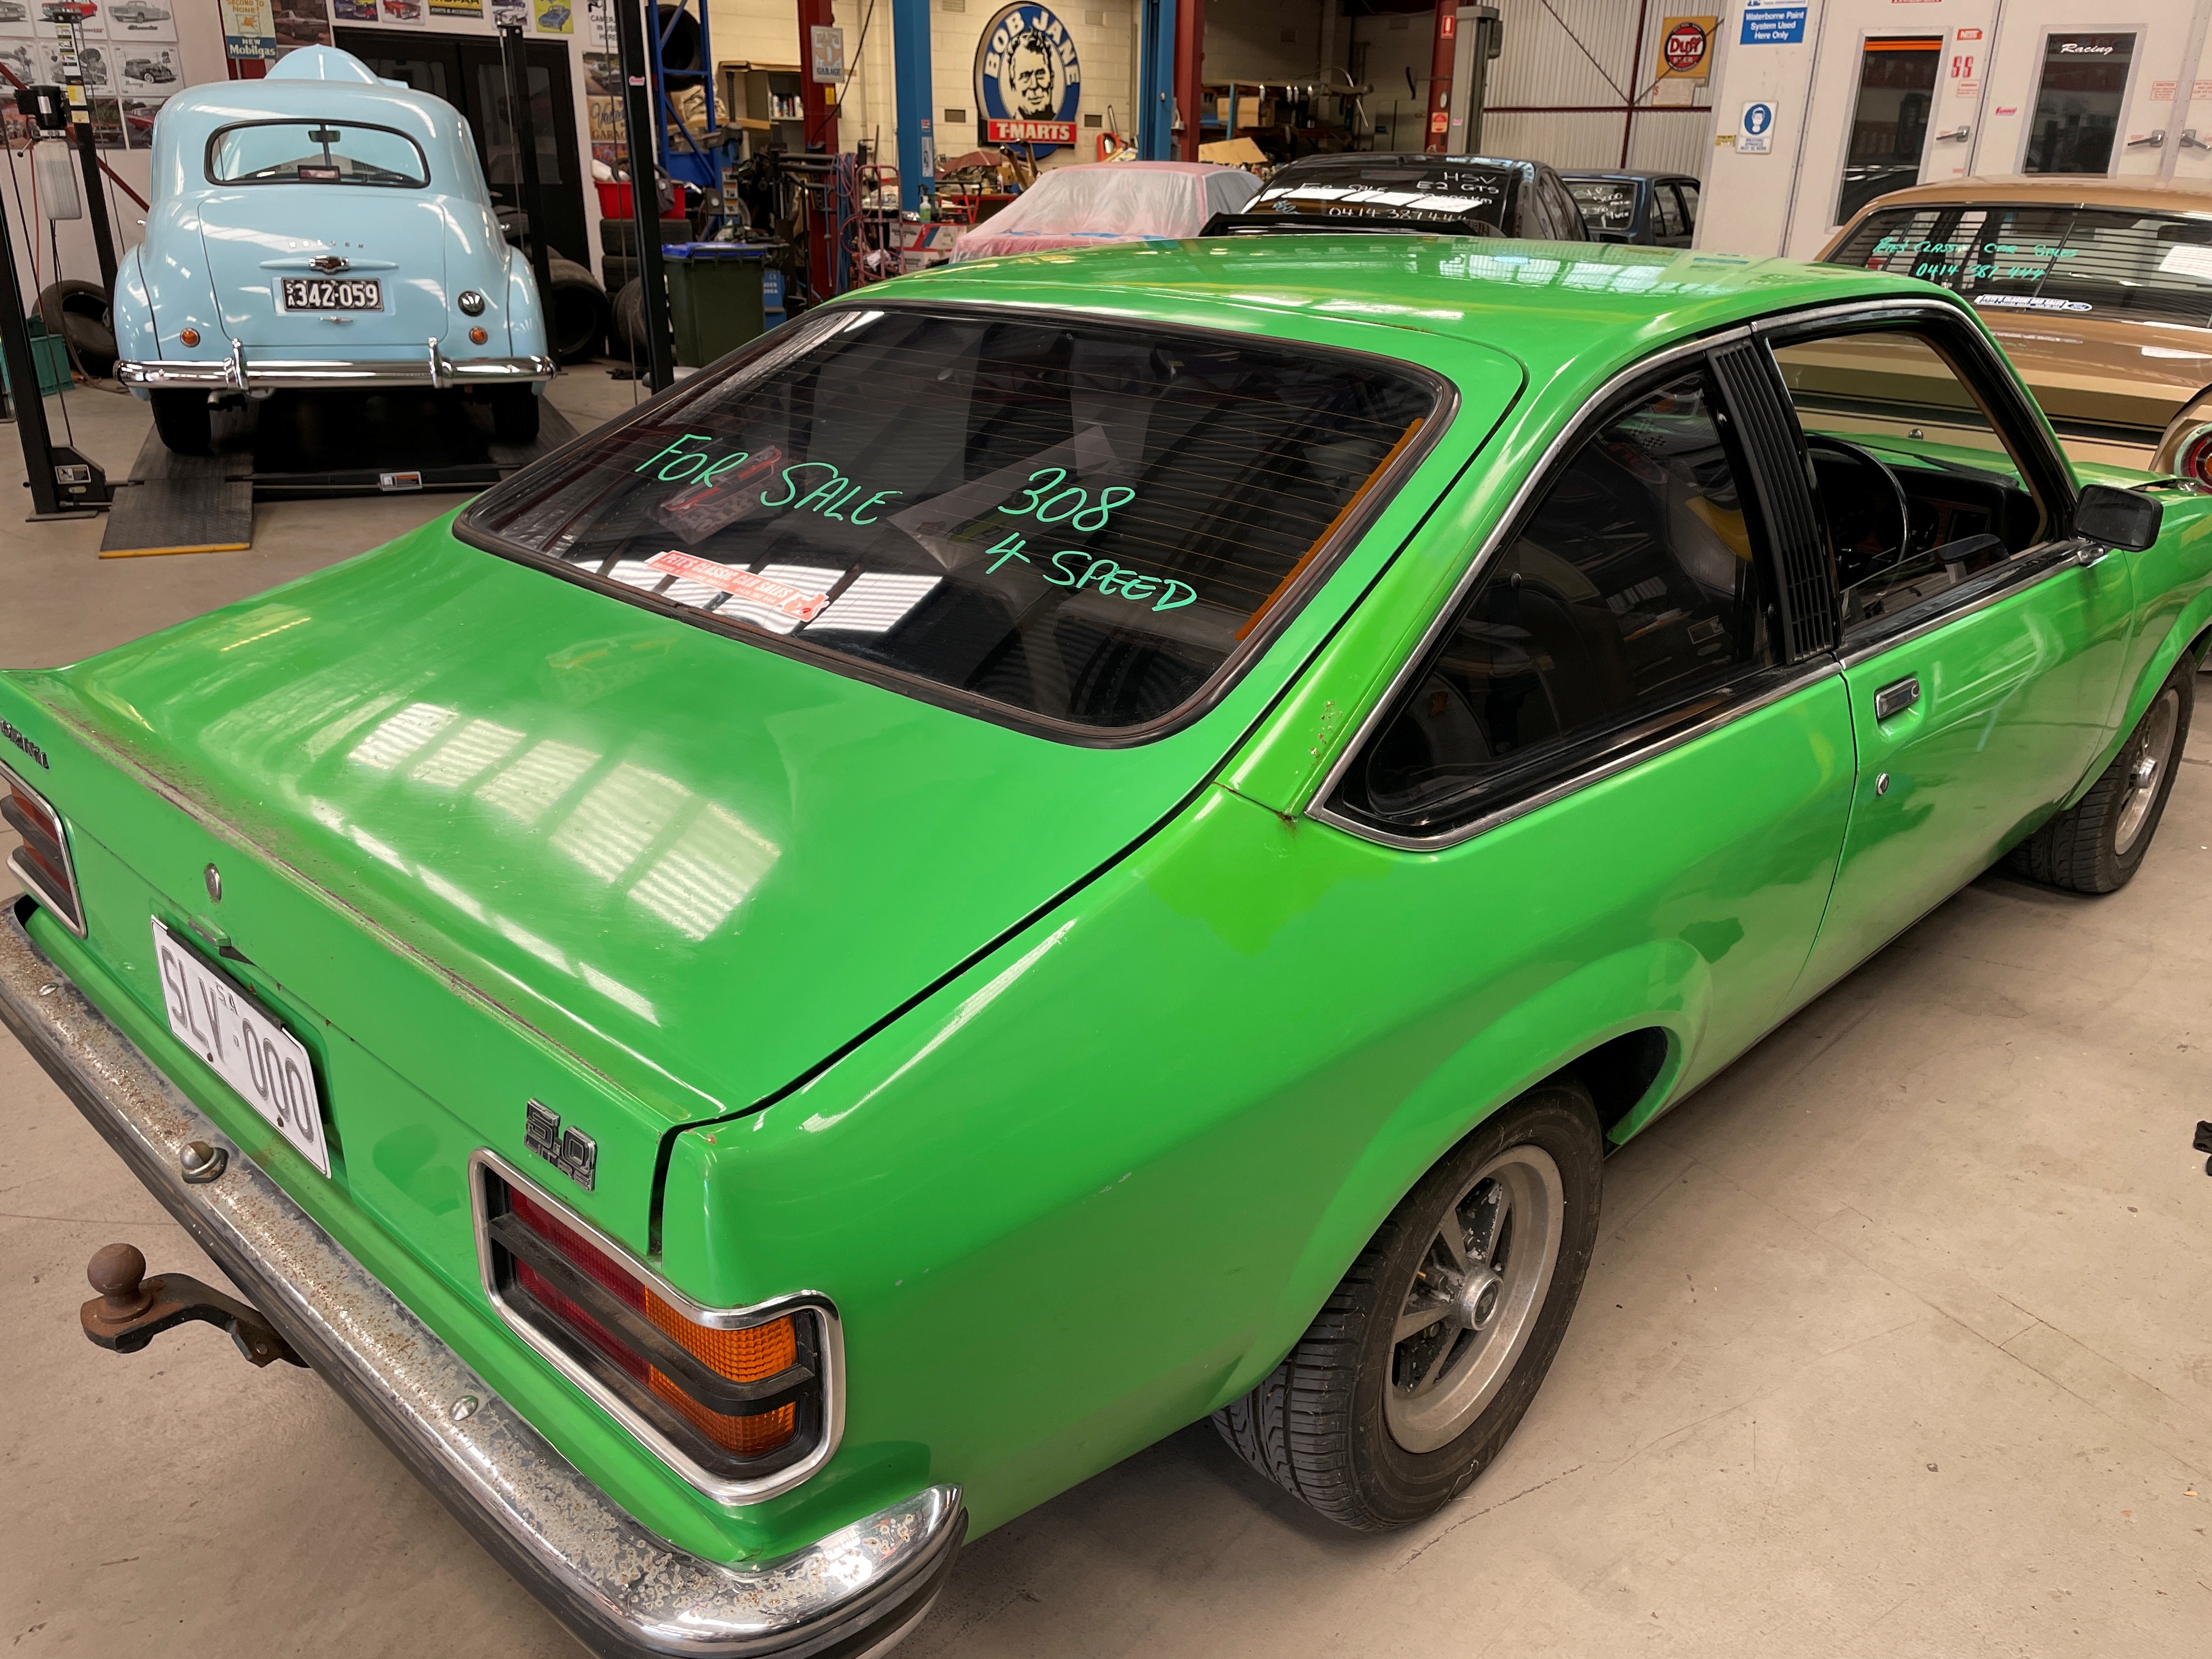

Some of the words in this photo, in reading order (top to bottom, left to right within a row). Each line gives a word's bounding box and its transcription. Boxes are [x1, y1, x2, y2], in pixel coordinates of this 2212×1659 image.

[1746, 12, 1785, 20] Waterborne
[1751, 22, 1776, 32] System
[1778, 20, 1796, 29] Used
[1754, 31, 1771, 40] Here
[1772, 31, 1789, 41] Only
[230, 44, 275, 58] Mobilgas
[985, 11, 1025, 78] BOB
[1032, 10, 1080, 86] JANE
[1670, 37, 1702, 53] Duff
[2061, 43, 2114, 55] Racing
[1951, 56, 1974, 78] SS
[996, 122, 1070, 141] T-MARTS
[1443, 171, 1497, 184] HSV
[1417, 180, 1449, 190] E2
[1460, 183, 1499, 194] GTS
[1329, 207, 1380, 217] 0414
[1916, 263, 1958, 277] 0414
[1968, 264, 1999, 278] 387
[2007, 266, 2046, 281] 444
[635, 434, 749, 487] FOR
[760, 462, 903, 524] SALE
[997, 467, 1136, 531] 308
[662, 554, 699, 569] PETE'S
[692, 562, 739, 581] CLASSIC
[732, 574, 762, 588] CAR
[754, 582, 794, 599] SALES
[985, 532, 1031, 574] 4
[1043, 551, 1197, 612] SPEED
